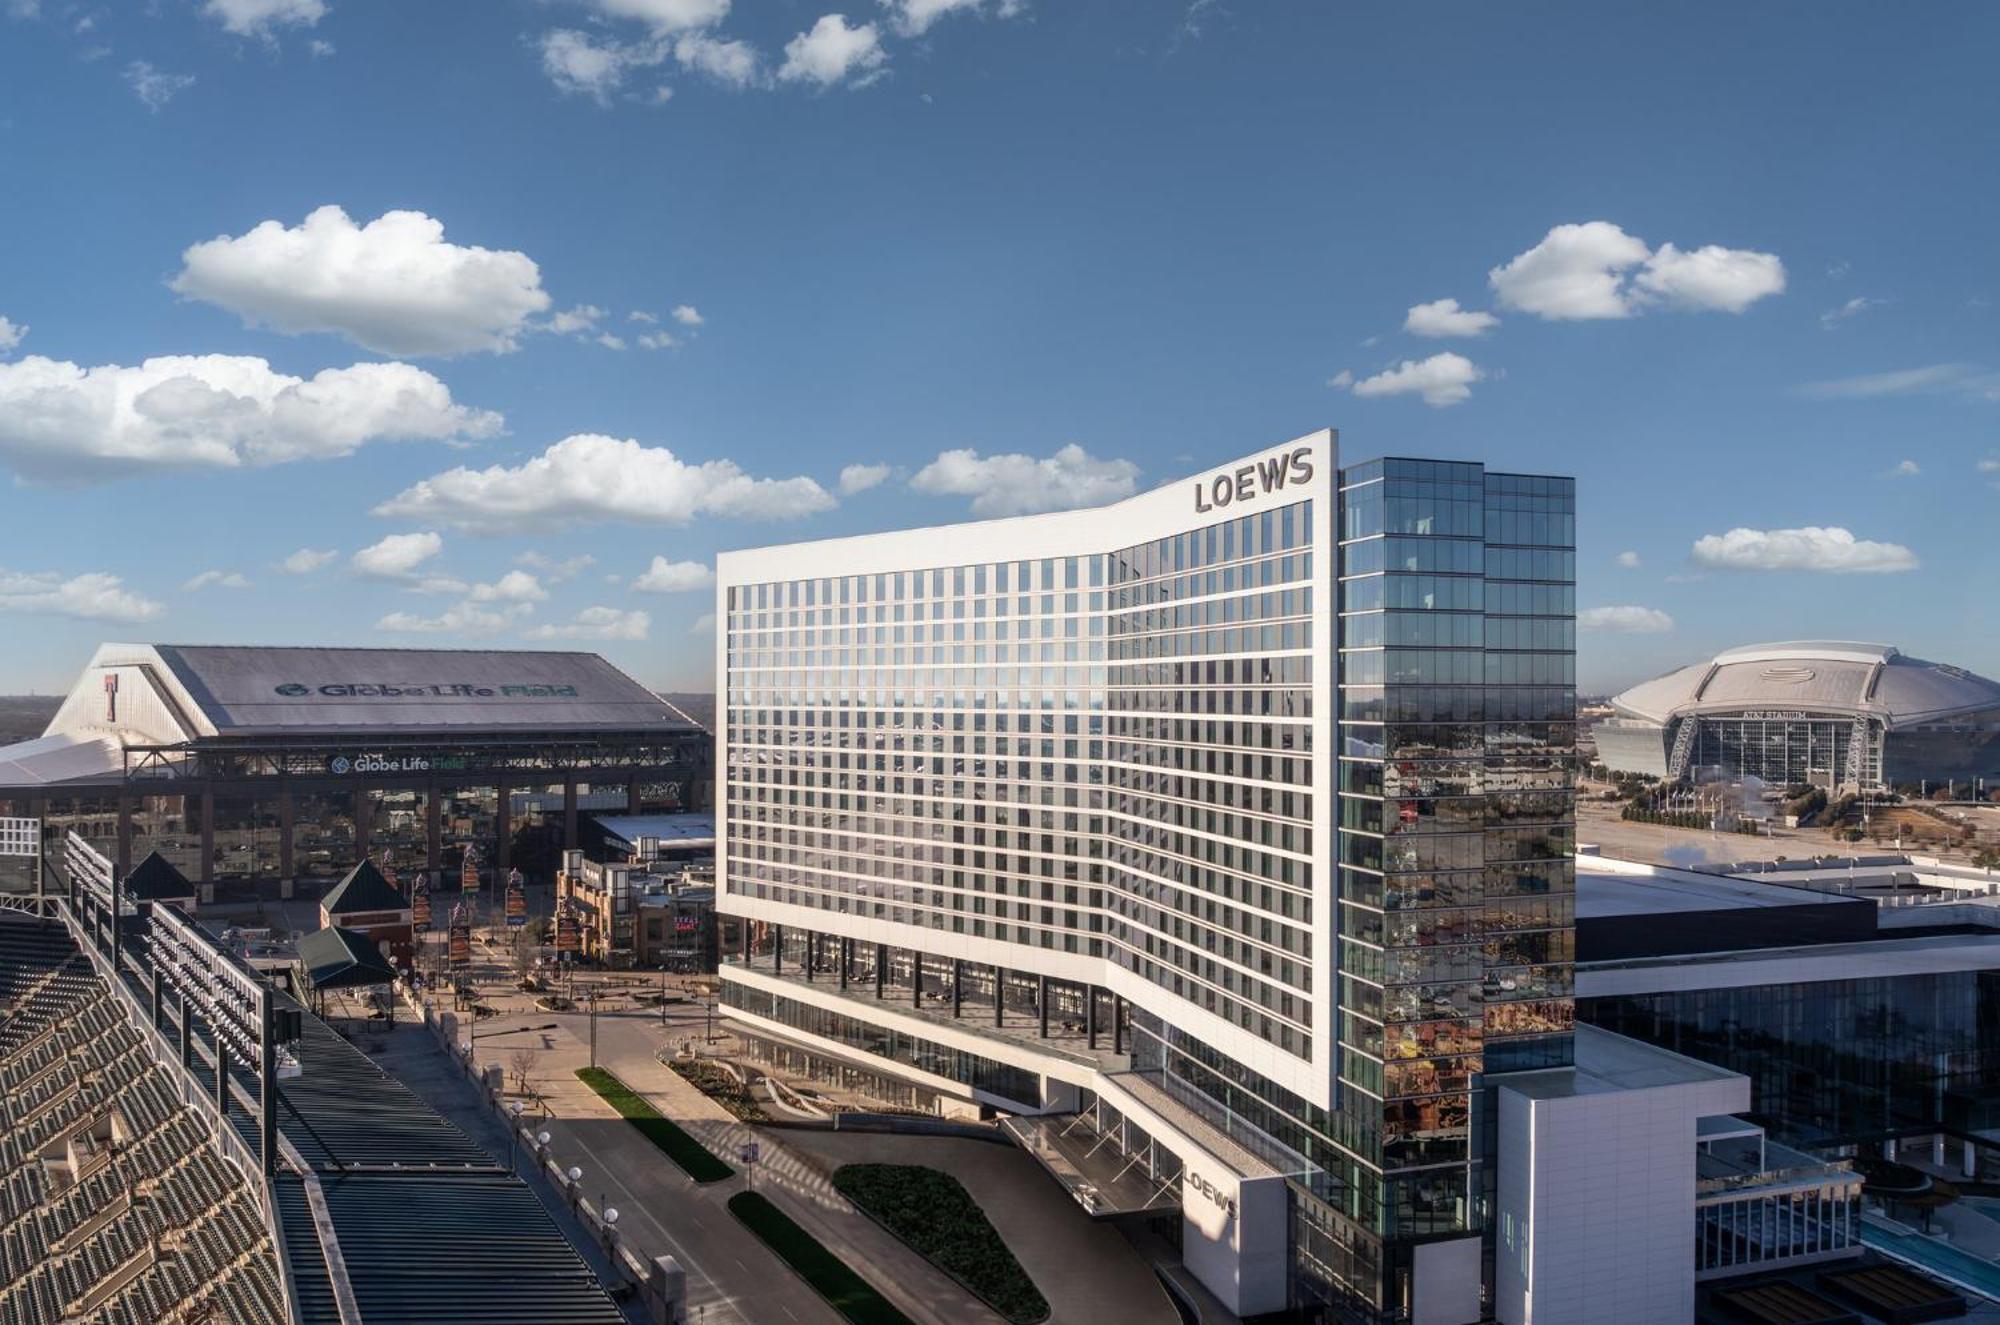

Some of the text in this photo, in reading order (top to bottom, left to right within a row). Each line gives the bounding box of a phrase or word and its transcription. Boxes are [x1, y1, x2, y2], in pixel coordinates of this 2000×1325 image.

[1195, 447, 1314, 513] LOEWS
[104, 674, 118, 722] T
[318, 683, 578, 697] Globe Life Field
[1743, 711, 1806, 720] AT&T STADIUM
[354, 757, 465, 771] Globe Life Field
[1182, 1163, 1237, 1219] LOEWS
